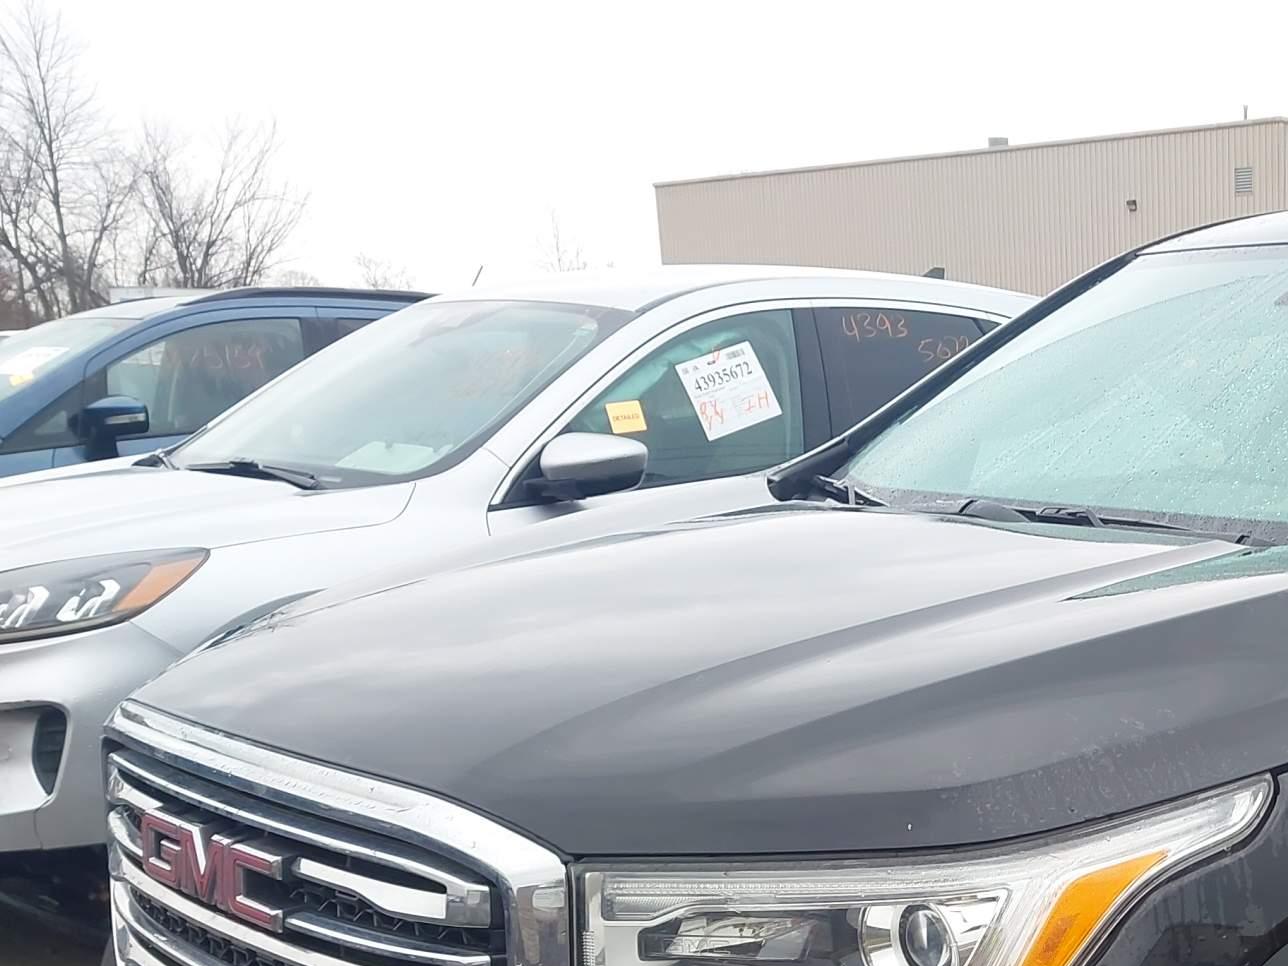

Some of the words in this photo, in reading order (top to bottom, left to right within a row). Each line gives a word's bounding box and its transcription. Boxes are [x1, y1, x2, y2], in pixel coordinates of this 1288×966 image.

[841, 311, 909, 344] 4393
[693, 361, 753, 393] 43935672
[140, 808, 283, 933] GMC
